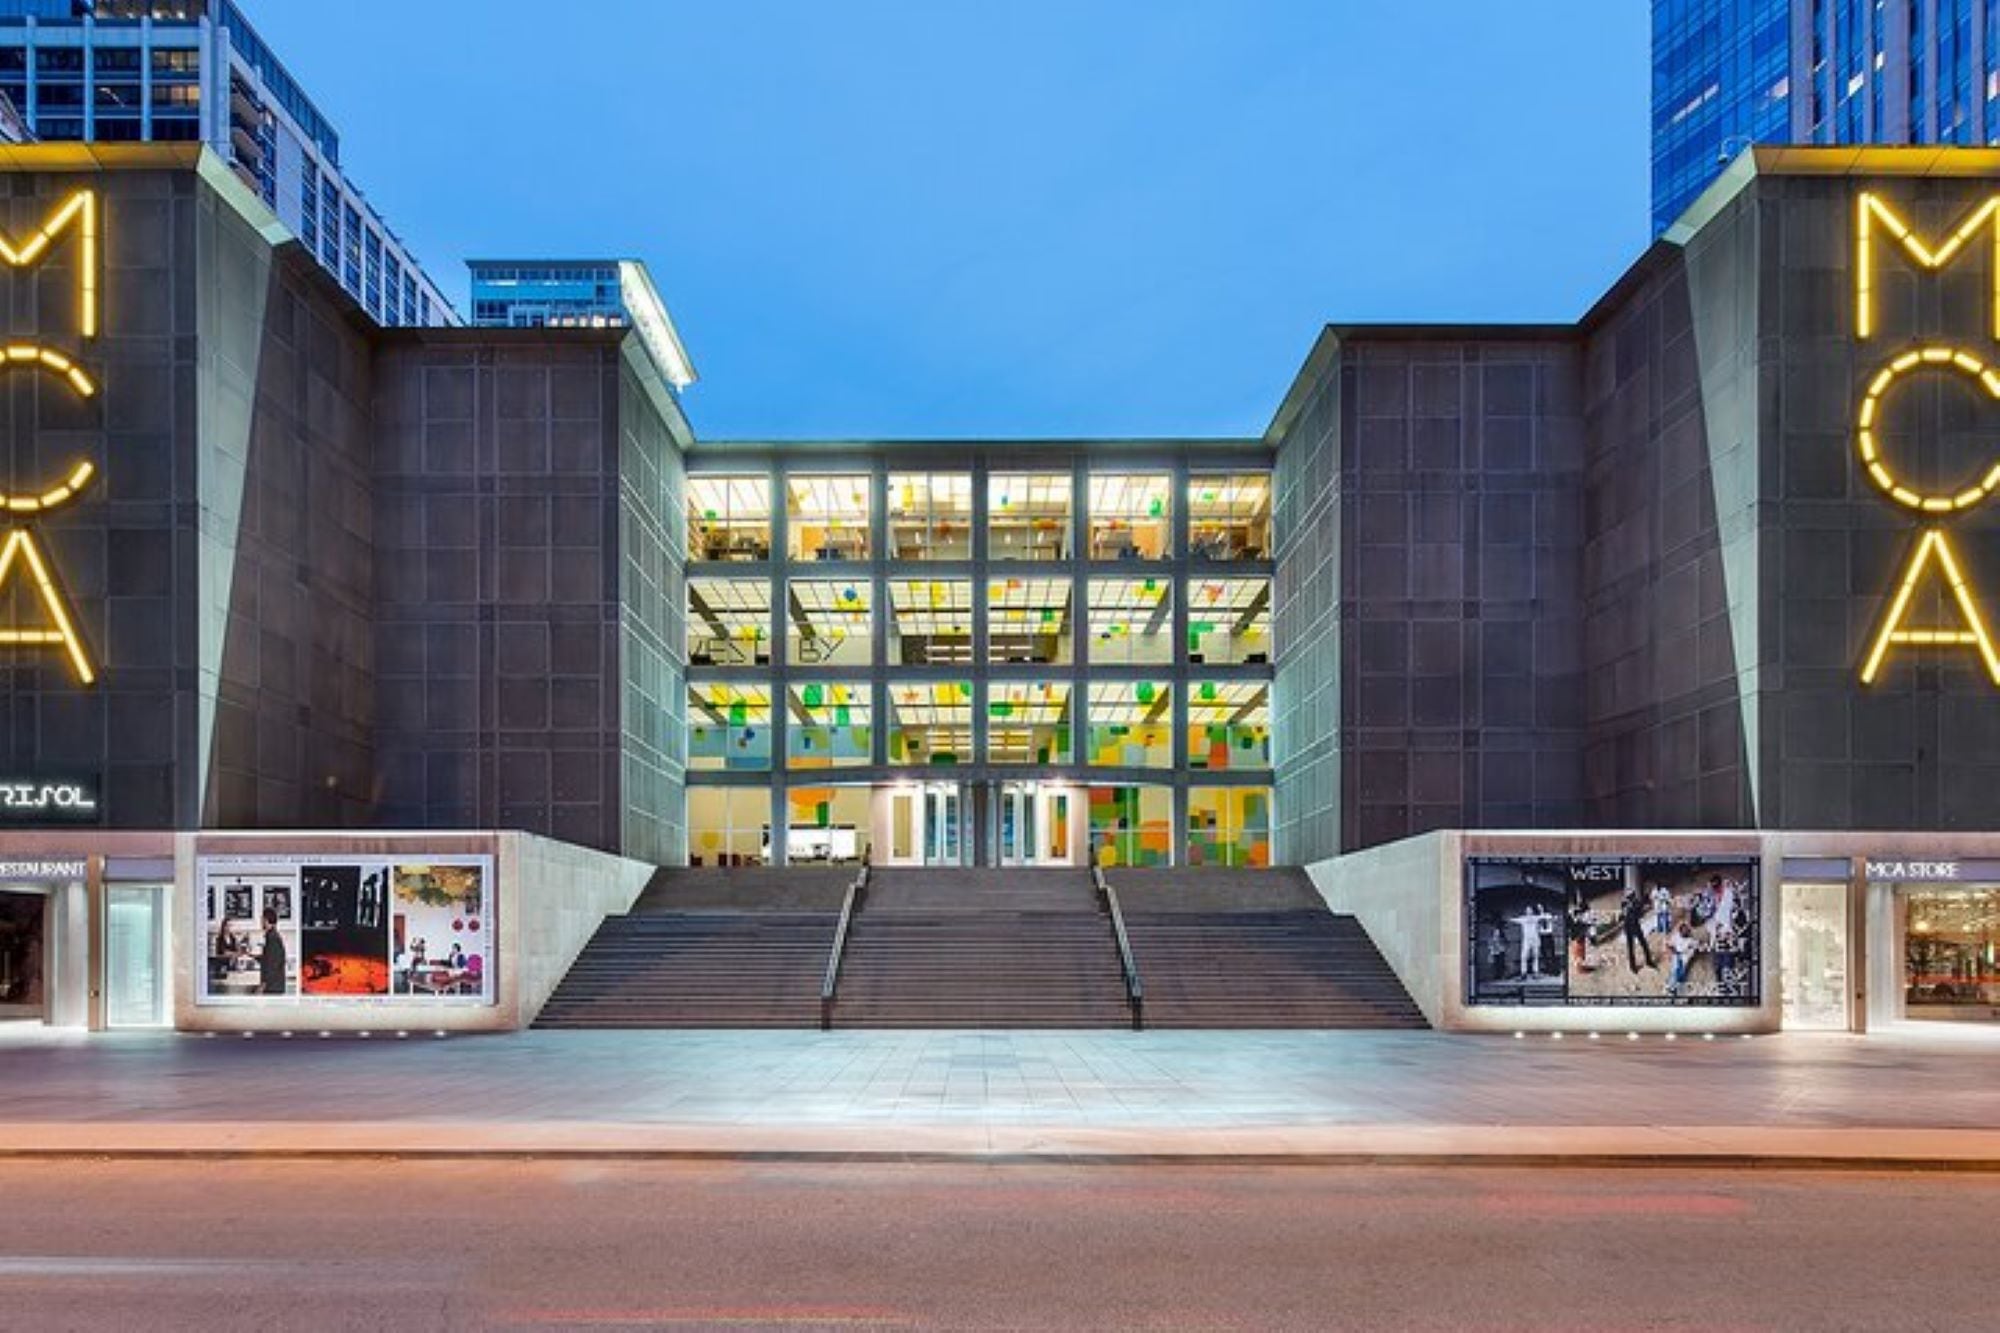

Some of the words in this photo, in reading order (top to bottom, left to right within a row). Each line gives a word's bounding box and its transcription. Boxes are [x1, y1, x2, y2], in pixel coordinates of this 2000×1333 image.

[1857, 191, 2000, 685] MCA
[1570, 865, 1622, 880] WEST
[1865, 862, 1906, 877] MCA
[1909, 862, 1958, 877] STORE
